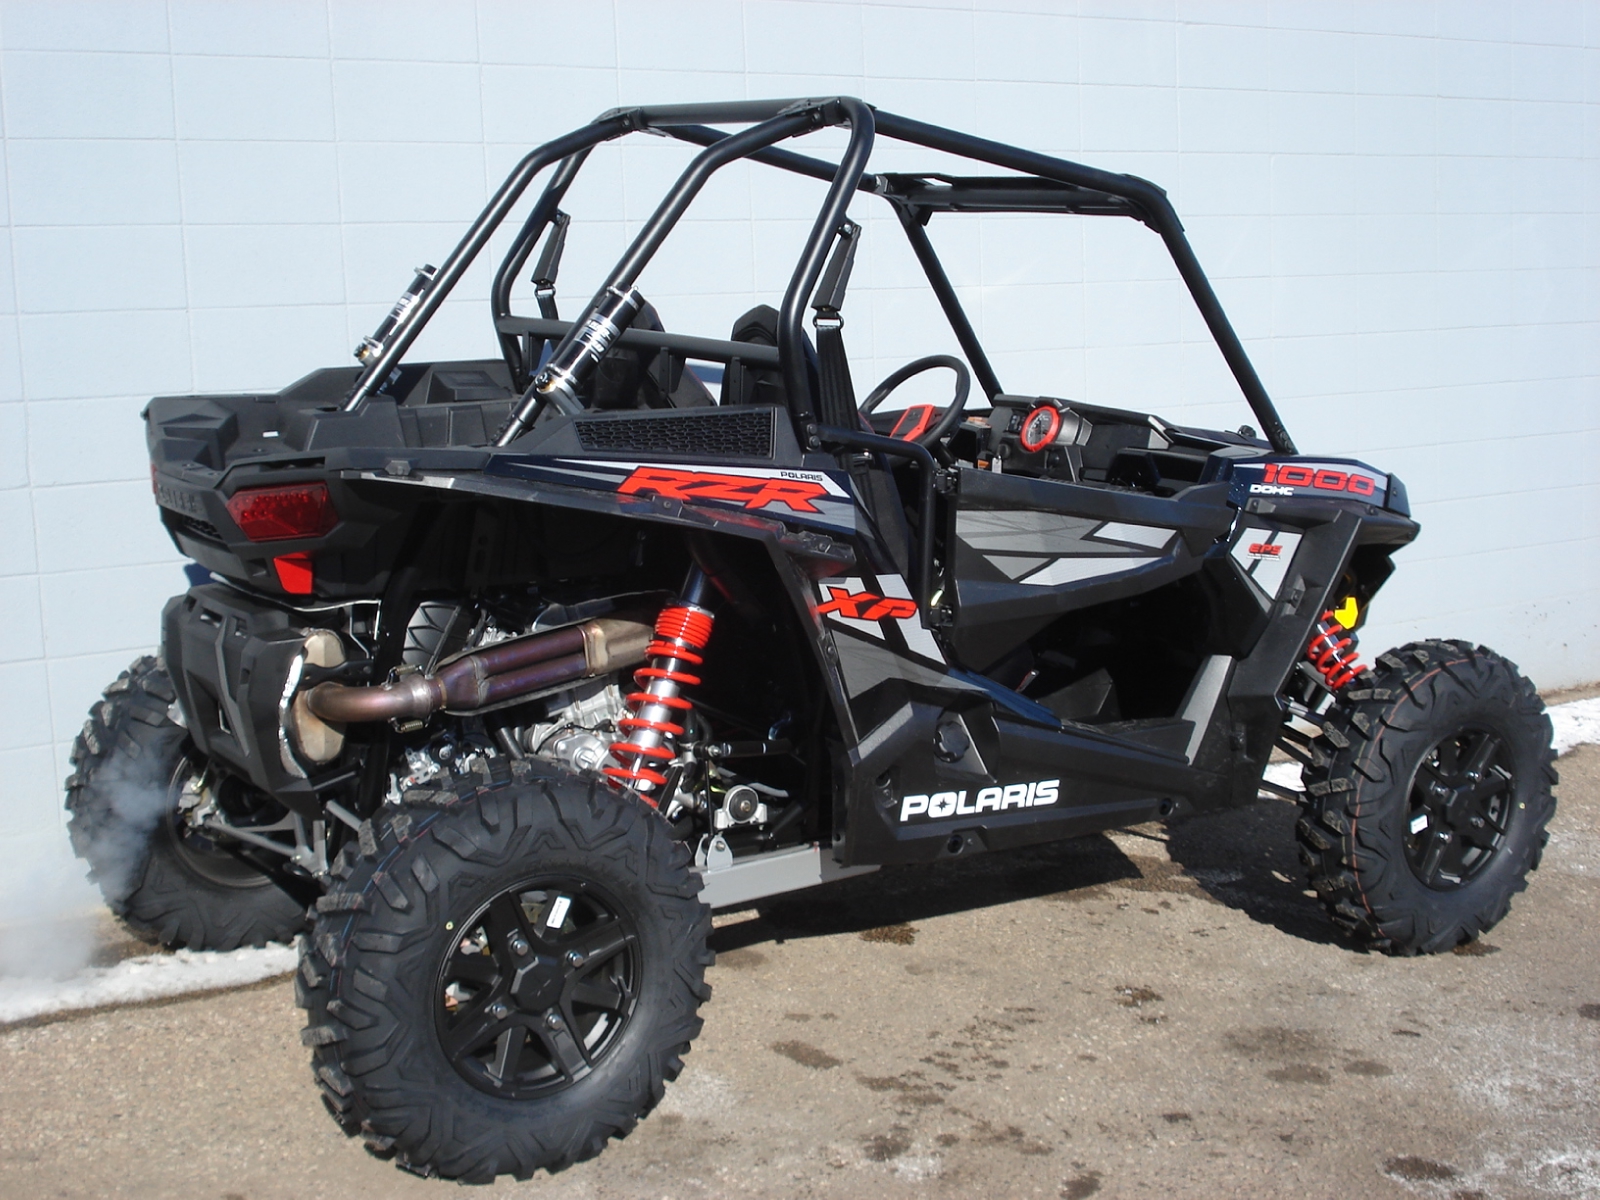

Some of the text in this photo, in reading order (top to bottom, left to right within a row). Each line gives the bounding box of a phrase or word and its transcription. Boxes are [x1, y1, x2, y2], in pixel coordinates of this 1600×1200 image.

[617, 465, 828, 514] RZR
[780, 471, 823, 481] POLARIS
[1249, 484, 1294, 496] DOHC
[1264, 463, 1375, 496] 1000
[1249, 543, 1283, 555] EPS
[816, 587, 917, 621] XP
[900, 779, 1060, 822] POLARIS
